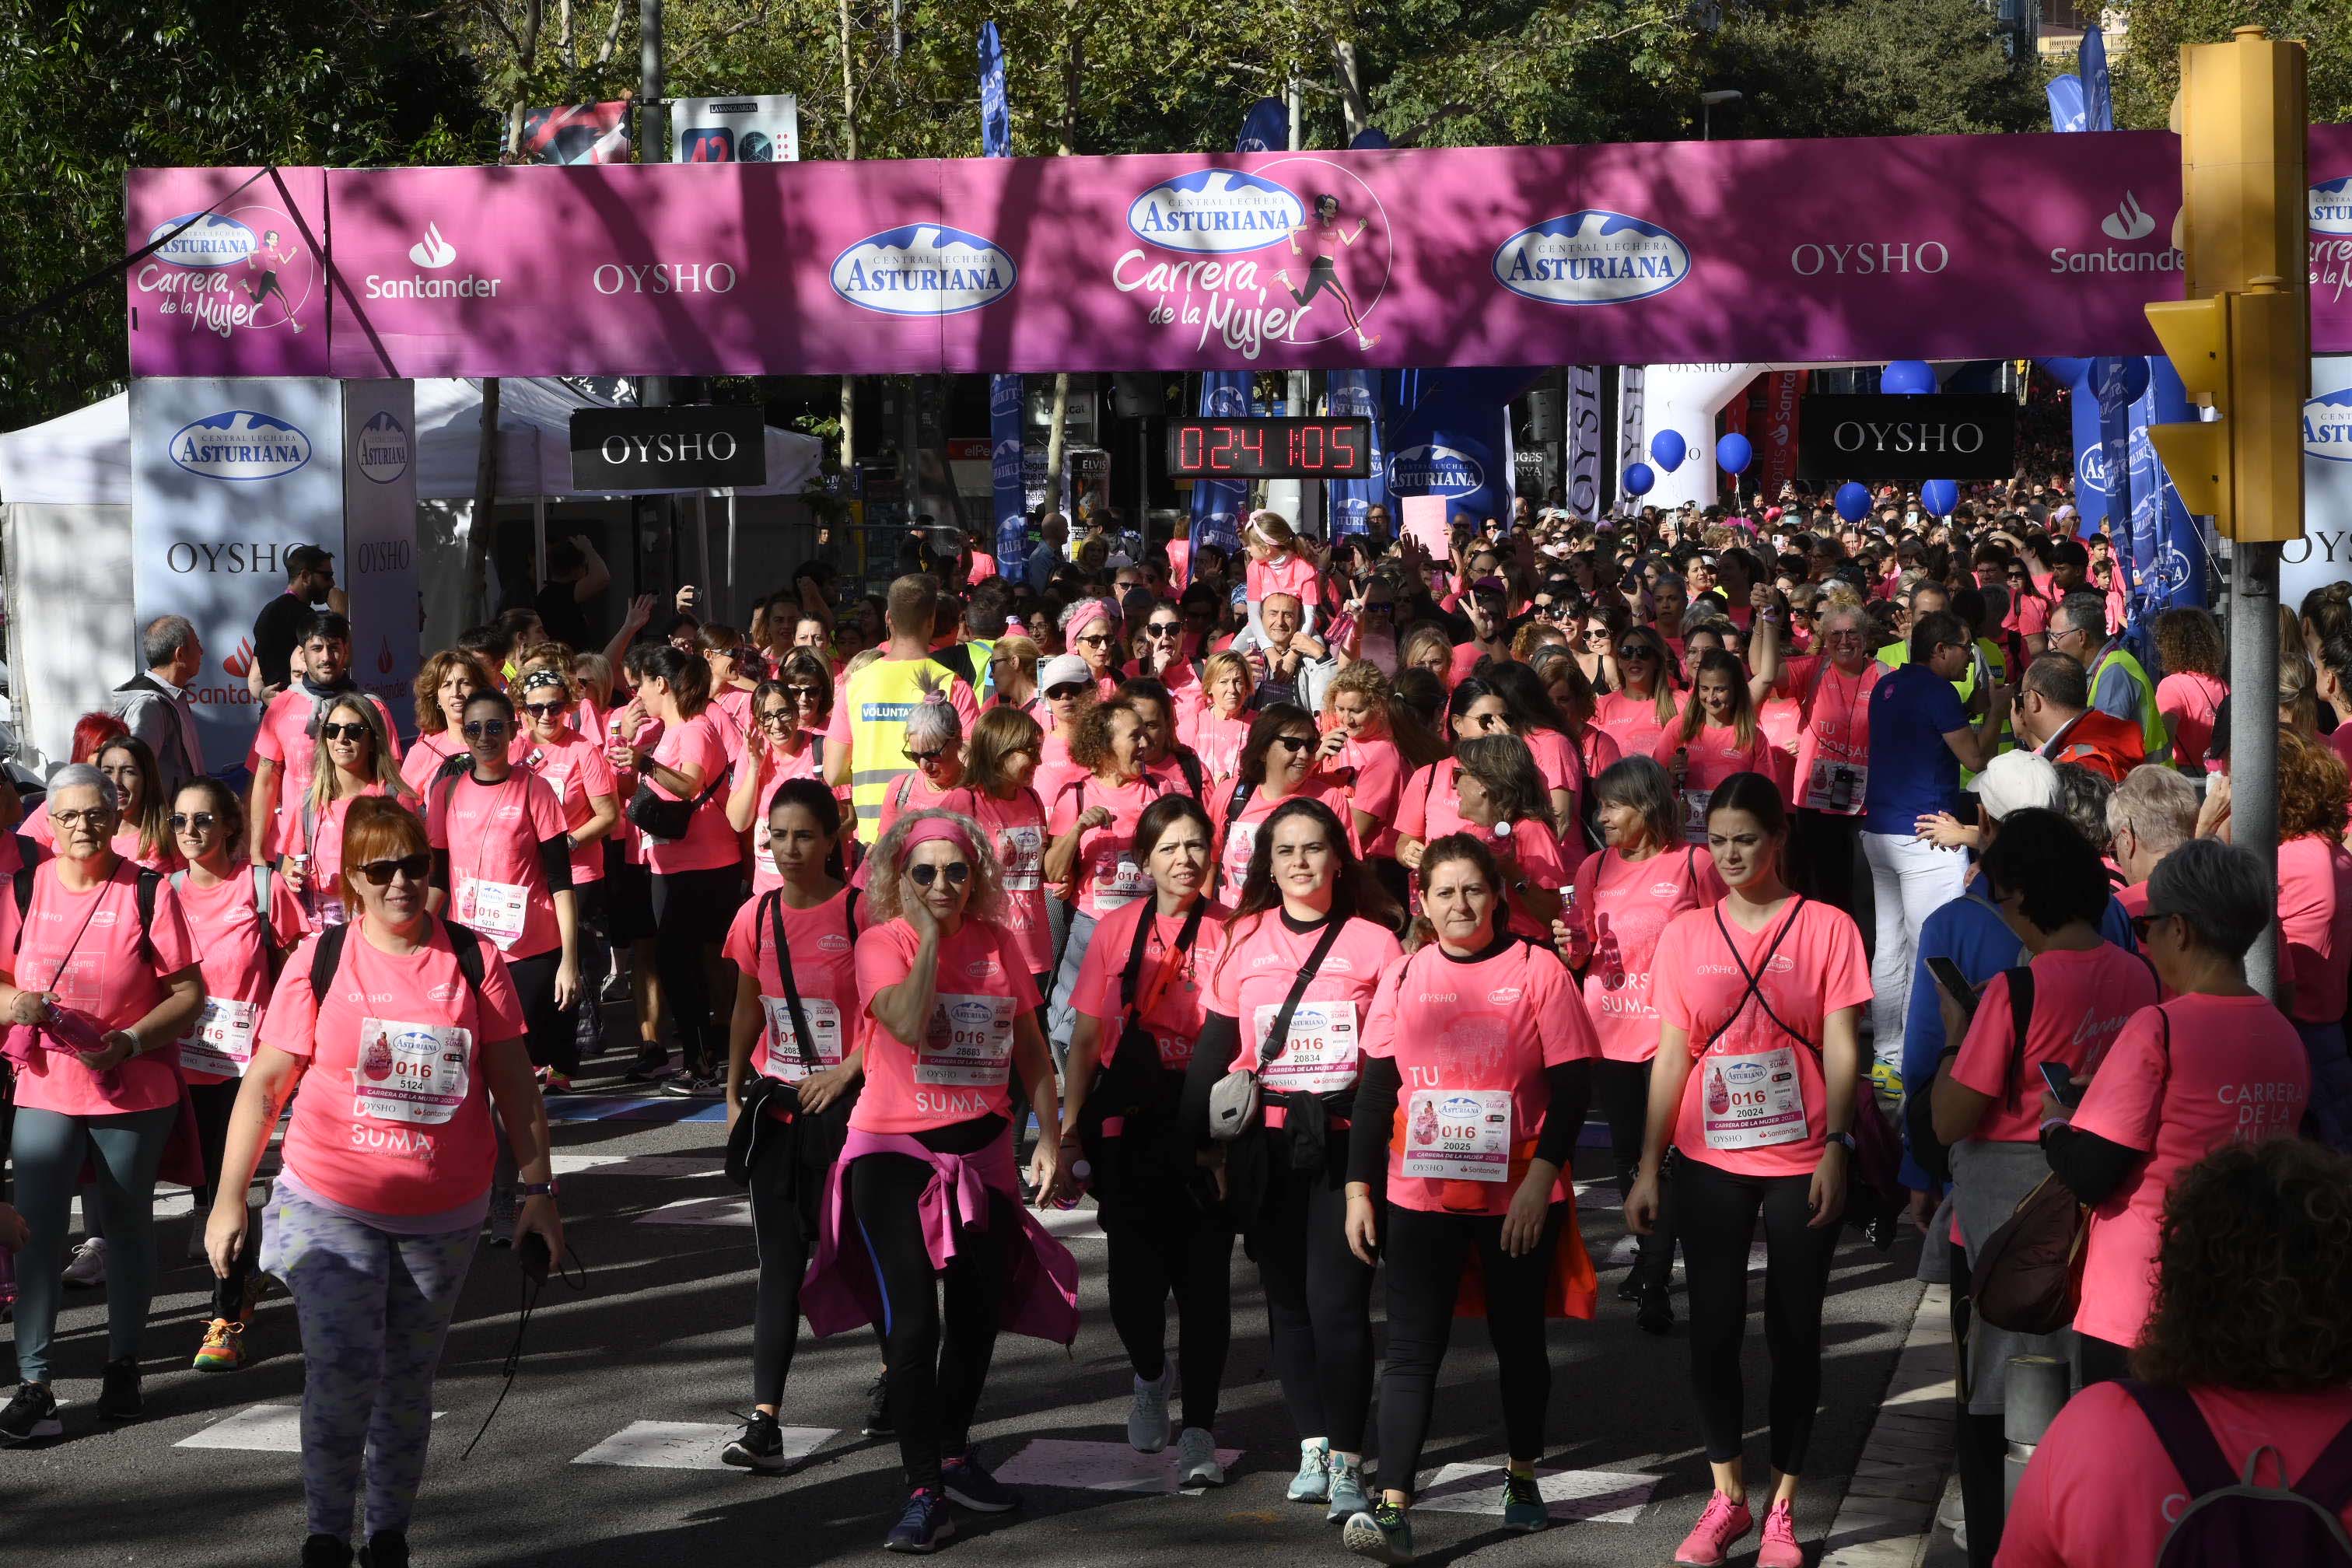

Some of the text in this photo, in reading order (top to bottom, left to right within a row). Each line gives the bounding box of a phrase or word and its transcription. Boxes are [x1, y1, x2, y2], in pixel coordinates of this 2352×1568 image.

[1168, 198, 1224, 207] CENTRAL
[1141, 201, 1291, 233] ASTURIANA
[1538, 241, 1668, 254] CENTRAL LECHERA
[873, 255, 933, 264] CENTRAL
[1507, 247, 1675, 282] ASTURIANA
[1791, 242, 1949, 275] OYSHO
[137, 264, 229, 293] Carrera
[593, 262, 737, 295] OYSHO
[845, 257, 1003, 292] ASTURIANA
[1112, 249, 1258, 292] Carrera
[366, 275, 501, 299] Santander
[159, 293, 194, 314] de la
[1148, 294, 1201, 324] de la
[192, 290, 263, 338] Mujer
[1196, 288, 1313, 360] Mujer
[1833, 422, 1984, 453] OYSHO
[180, 436, 301, 463] ASTURIANA
[360, 440, 407, 467] ASTURIANA
[601, 432, 736, 465] OYSHO
[1082, 460, 1107, 469] ELVIS
[1390, 467, 1478, 488] ASTURIANA
[358, 539, 410, 573] OYSHO
[1819, 721, 1836, 734] TU
[1818, 737, 1869, 758] DORSAL
[1017, 852, 1038, 861] 016
[1118, 871, 1141, 881] 016
[478, 906, 501, 919] 016
[1697, 964, 1738, 975] OYSHO
[1419, 993, 1457, 1003] OYSHO
[196, 1025, 224, 1040] 016
[780, 1031, 797, 1043] 01
[954, 1031, 985, 1044] 016
[397, 1039, 438, 1052] ASTURIANA
[1290, 1038, 1324, 1051] 016
[1293, 1054, 1321, 1062] 20834
[395, 1061, 432, 1078] 016
[1409, 1066, 1439, 1087] TU
[1727, 1071, 1764, 1080] ASTURIANA
[366, 1089, 397, 1097] CARRERA
[400, 1080, 423, 1091] 5124
[2217, 1083, 2303, 1104] CARRERA
[915, 1092, 990, 1113] SUMA
[1731, 1090, 1766, 1106] 016
[362, 1101, 396, 1112] OYSHO
[1737, 1108, 1764, 1118] 20024
[2238, 1104, 2290, 1125] DE LA
[352, 1124, 431, 1151] SUMA
[1441, 1126, 1476, 1139] 016
[1713, 1127, 1800, 1143] OYSHO Santander
[1444, 1142, 1472, 1151] 20025
[1468, 1166, 1501, 1175] Santander
